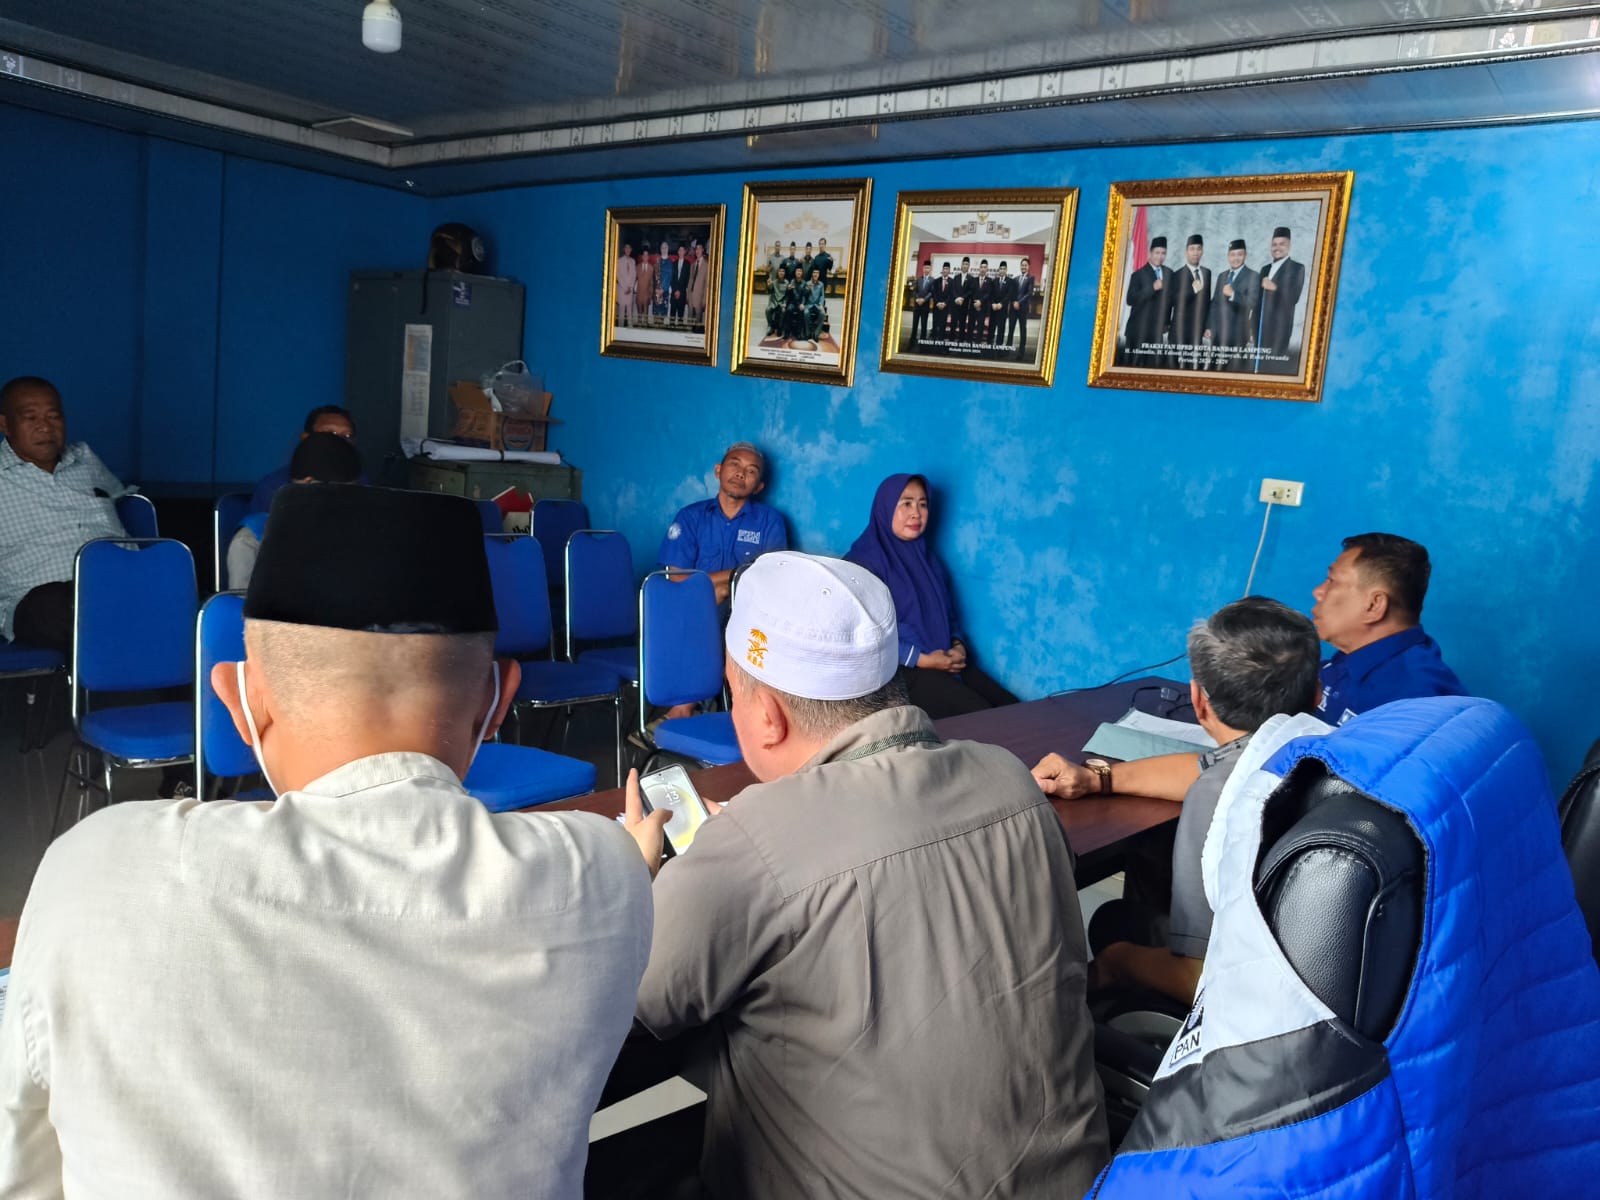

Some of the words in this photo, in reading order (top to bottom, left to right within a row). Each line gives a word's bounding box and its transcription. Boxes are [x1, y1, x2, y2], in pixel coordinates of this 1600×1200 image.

[1212, 345, 1239, 353] BANDAR
[1239, 346, 1272, 354] LAMPUNG
[1174, 1031, 1201, 1059] PAN
